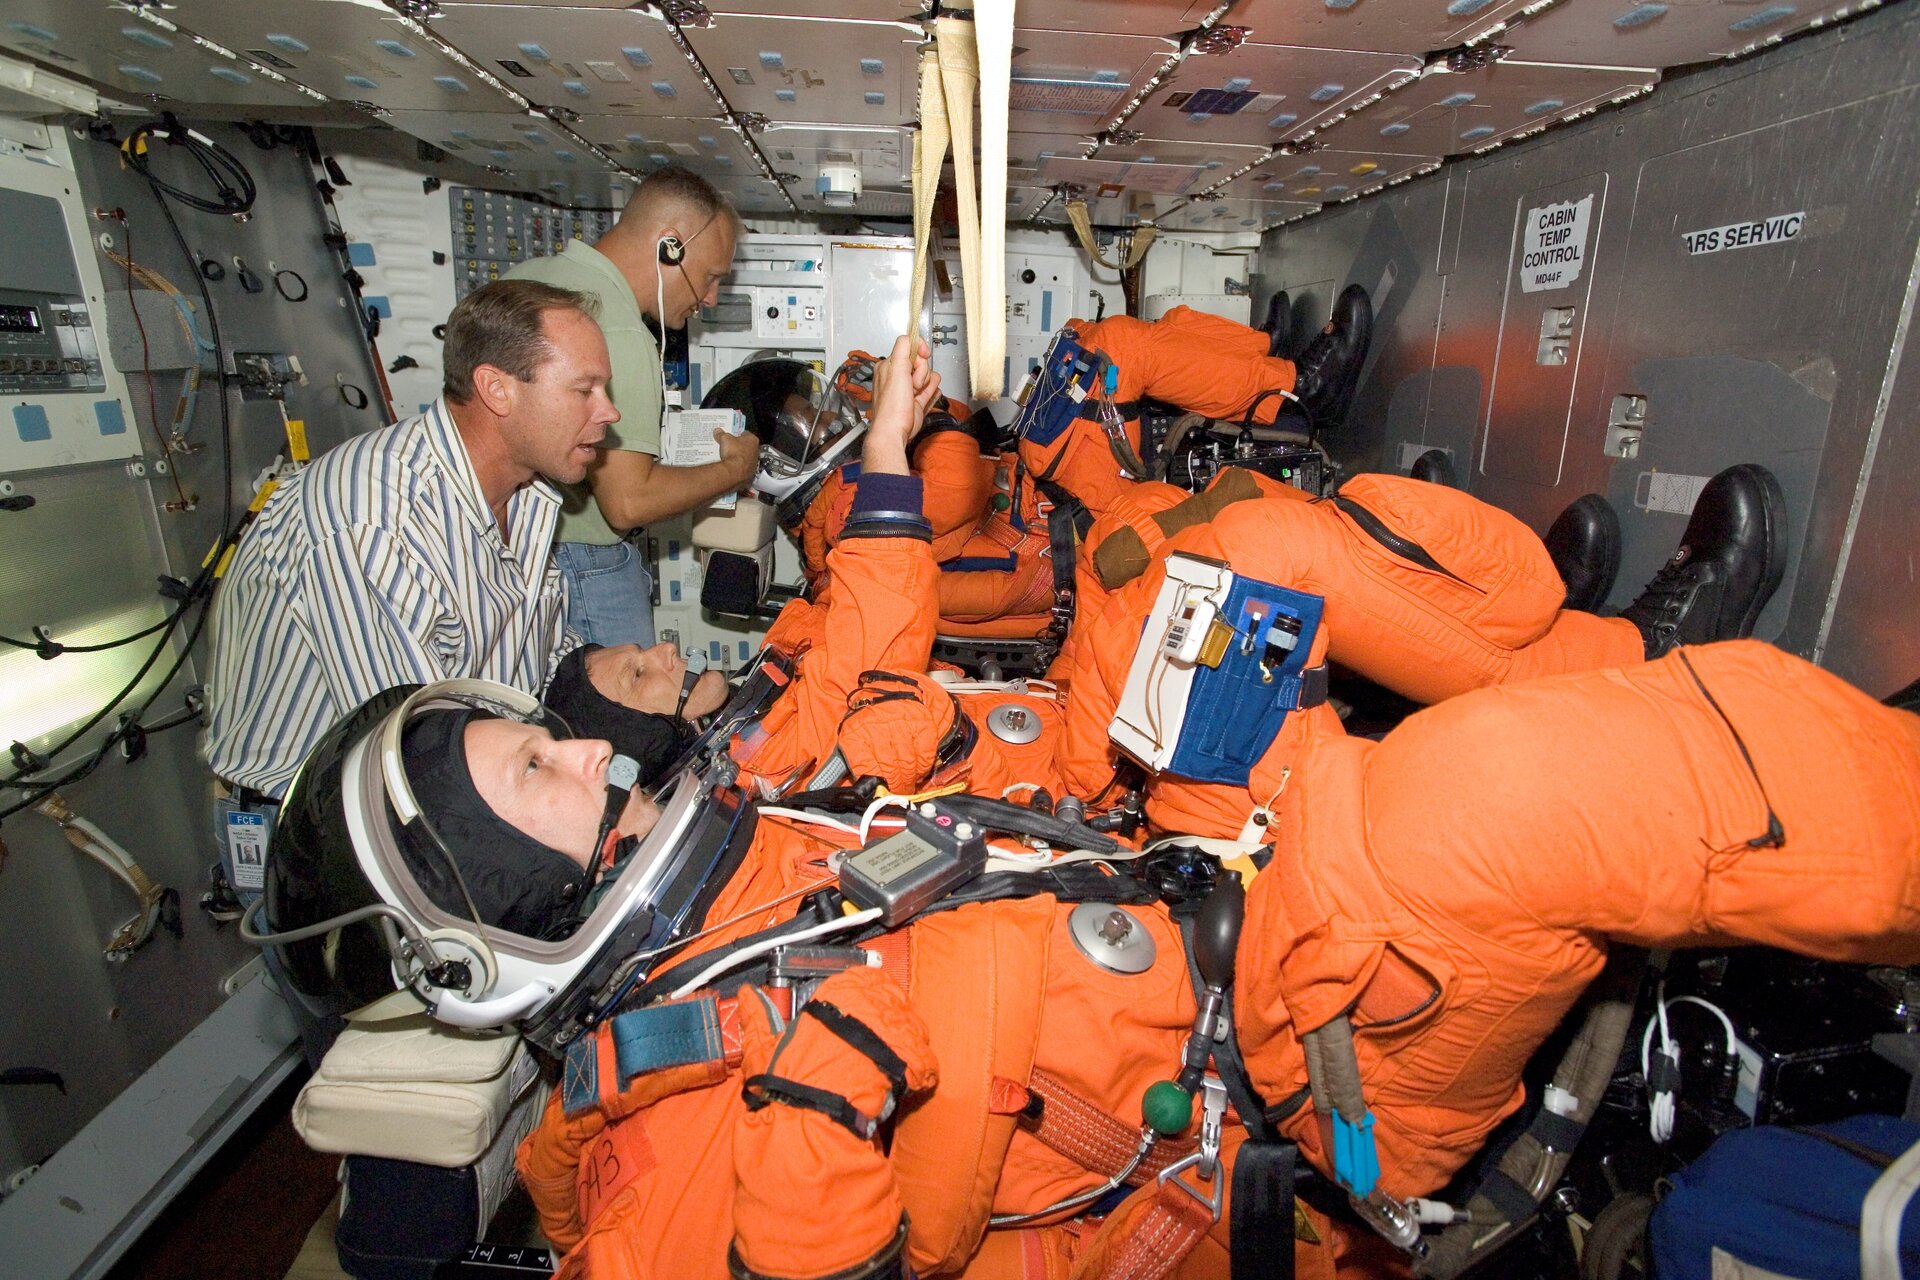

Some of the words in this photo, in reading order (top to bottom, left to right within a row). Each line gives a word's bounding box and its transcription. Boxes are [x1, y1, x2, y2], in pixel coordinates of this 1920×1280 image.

[1539, 207, 1577, 229] CABIN
[1539, 227, 1572, 248] TEMP
[1724, 216, 1804, 248] SERVIC
[1524, 245, 1580, 268] CONTROL
[237, 815, 255, 825] FCE
